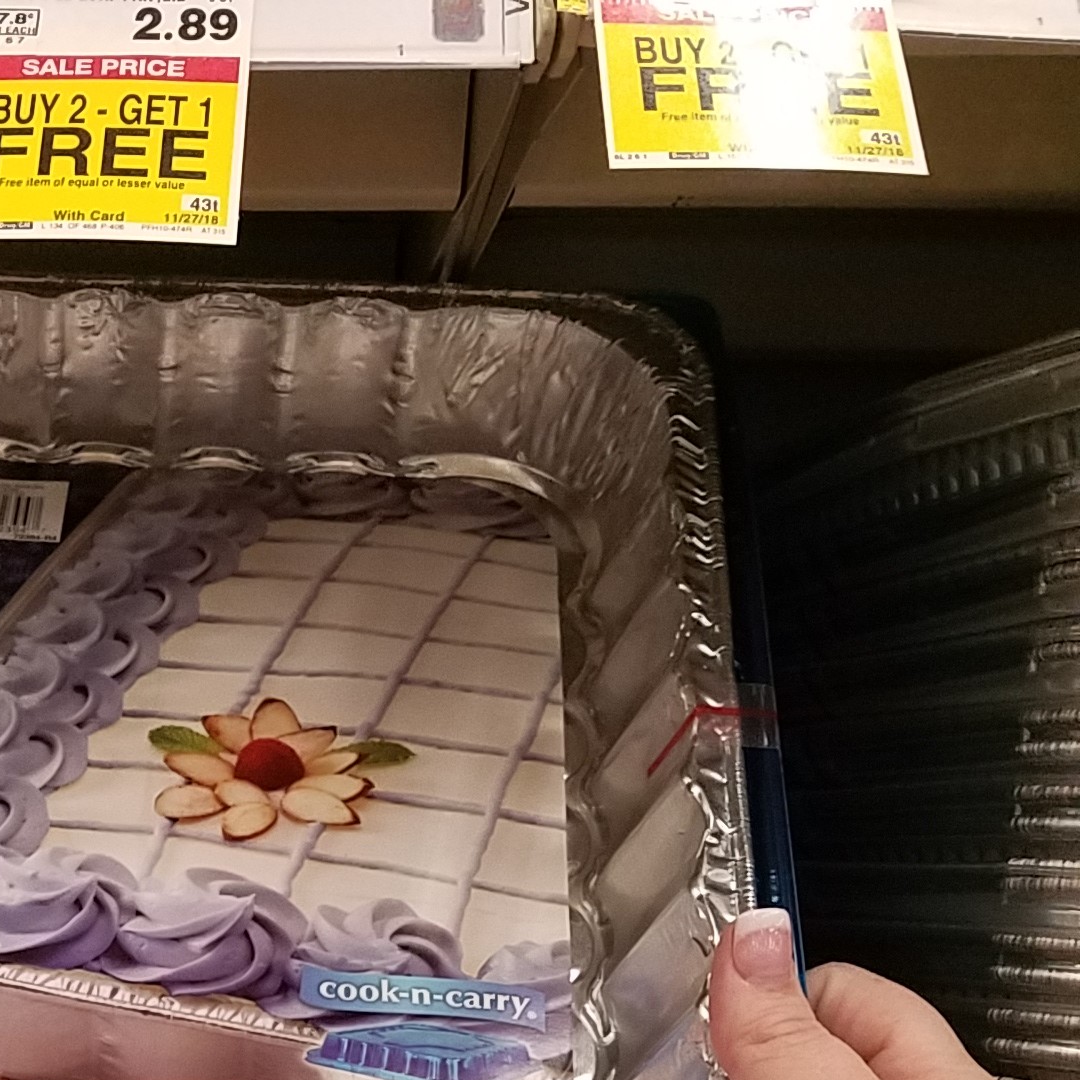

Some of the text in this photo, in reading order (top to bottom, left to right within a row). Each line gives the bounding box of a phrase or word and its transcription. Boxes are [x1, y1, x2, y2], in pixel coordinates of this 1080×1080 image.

[132, 8, 238, 41] 2.89
[635, 36, 705, 64] BUY
[21, 59, 186, 78] SALE PRICE
[69, 95, 87, 125] 2
[120, 95, 188, 126] GET
[199, 97, 211, 127] 1
[870, 132, 901, 146] 43t
[0, 177, 185, 190] Free item of equal or lesser value
[190, 198, 218, 212] 43t
[53, 209, 125, 222] With Card
[164, 213, 219, 225] 11/27/18
